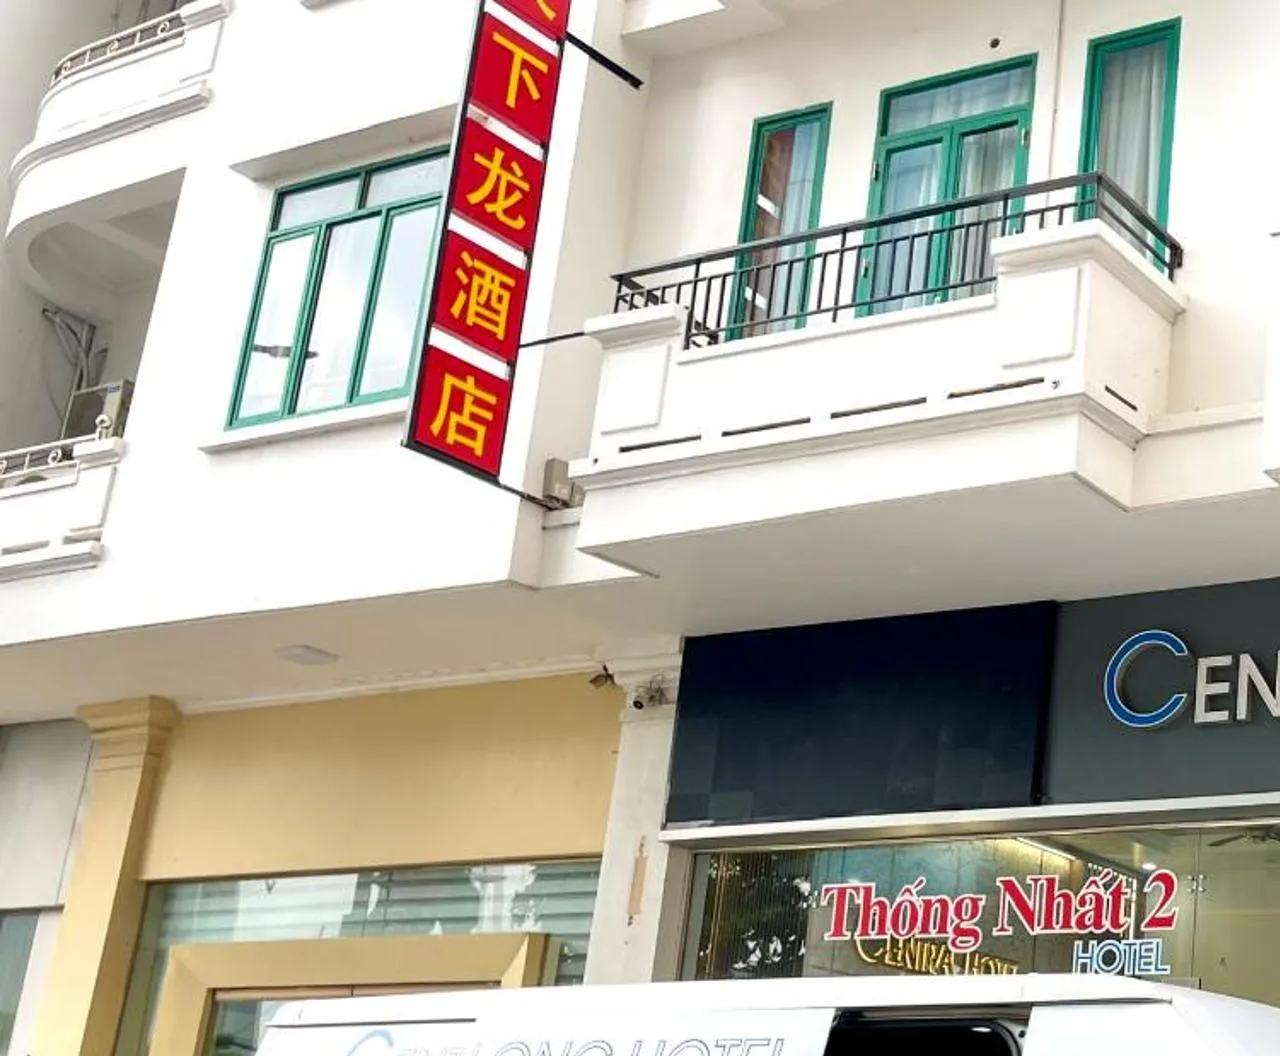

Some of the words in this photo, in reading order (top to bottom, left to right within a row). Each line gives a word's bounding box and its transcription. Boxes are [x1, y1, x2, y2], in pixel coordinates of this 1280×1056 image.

[431, 0, 557, 457] 下龙酒店
[820, 876, 983, 954] Thống
[993, 868, 1130, 936] Nhất
[1141, 868, 1179, 933] 2
[1073, 938, 1170, 975] HOTEL
